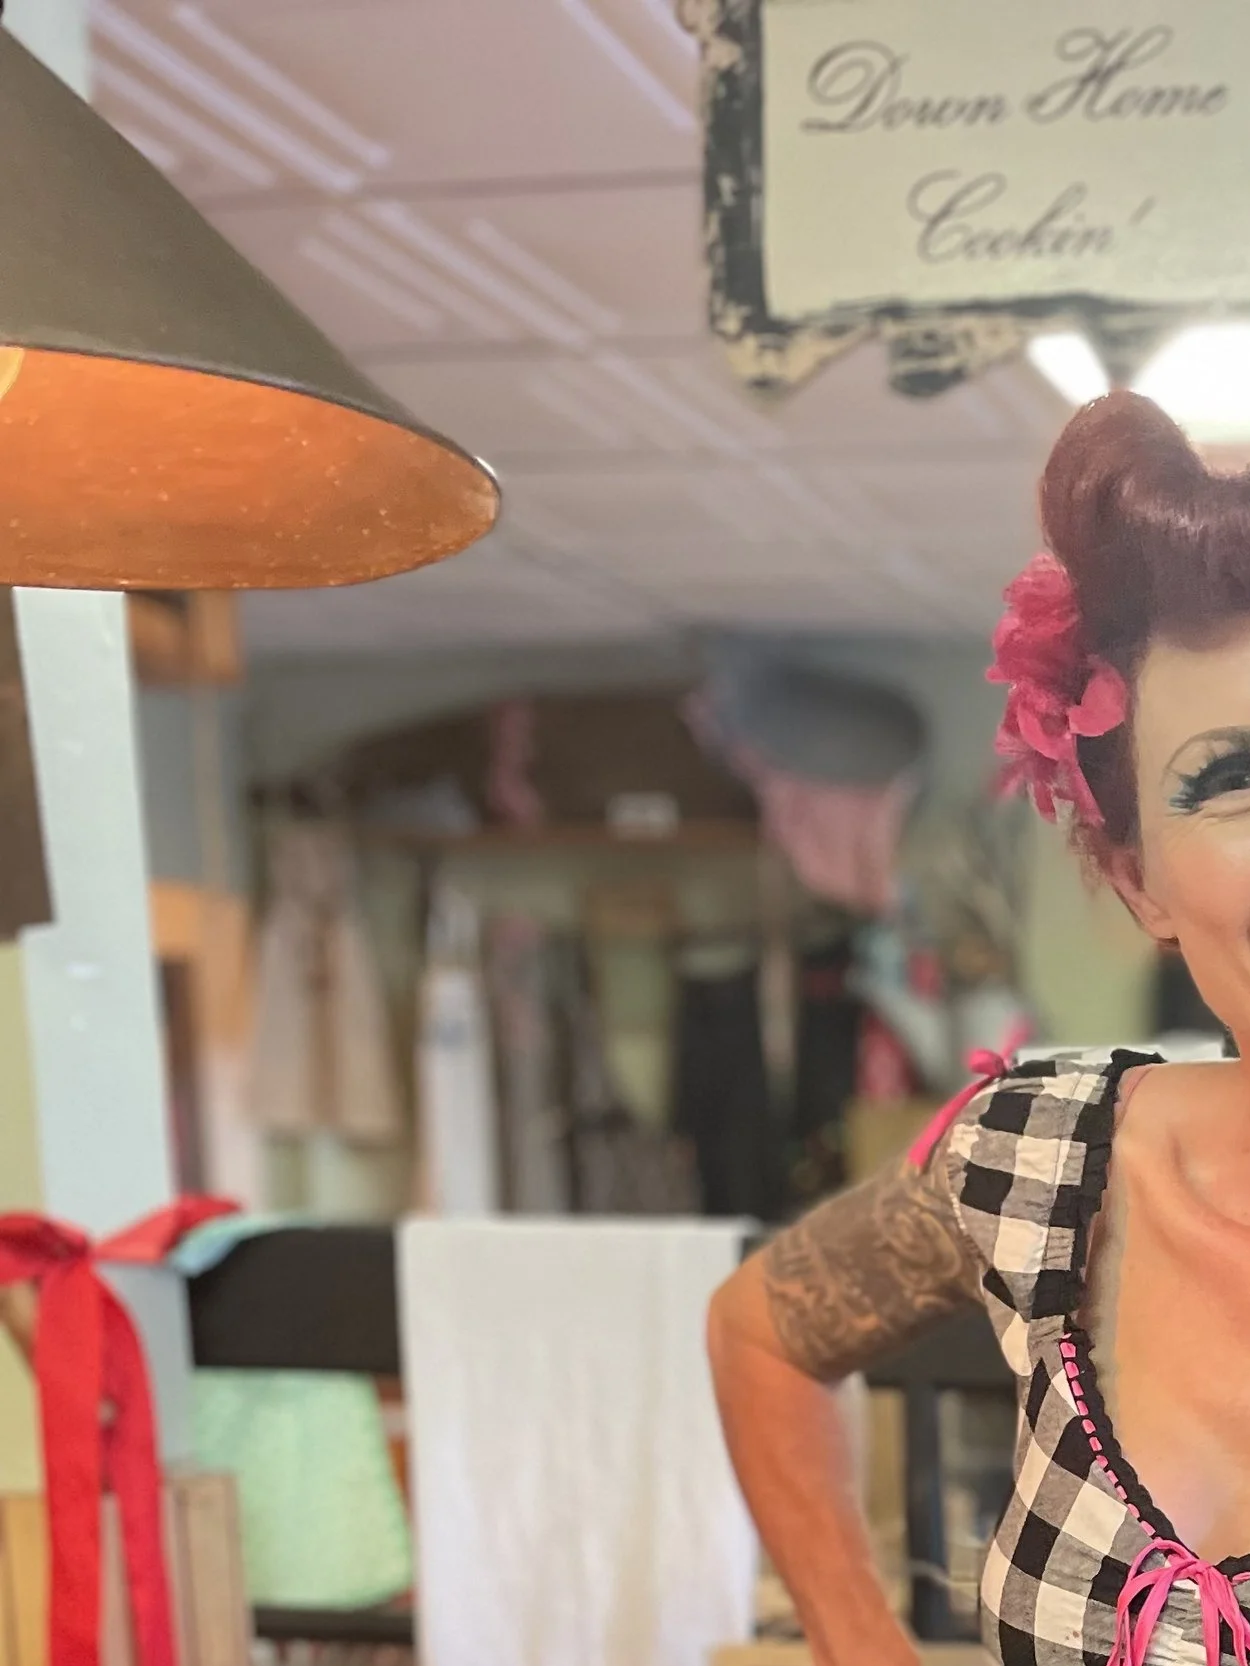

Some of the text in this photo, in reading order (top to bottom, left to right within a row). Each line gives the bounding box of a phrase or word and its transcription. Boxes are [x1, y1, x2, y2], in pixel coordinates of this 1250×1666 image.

[800, 24, 1230, 134] Down Home
[905, 168, 1157, 265] Cookin'
